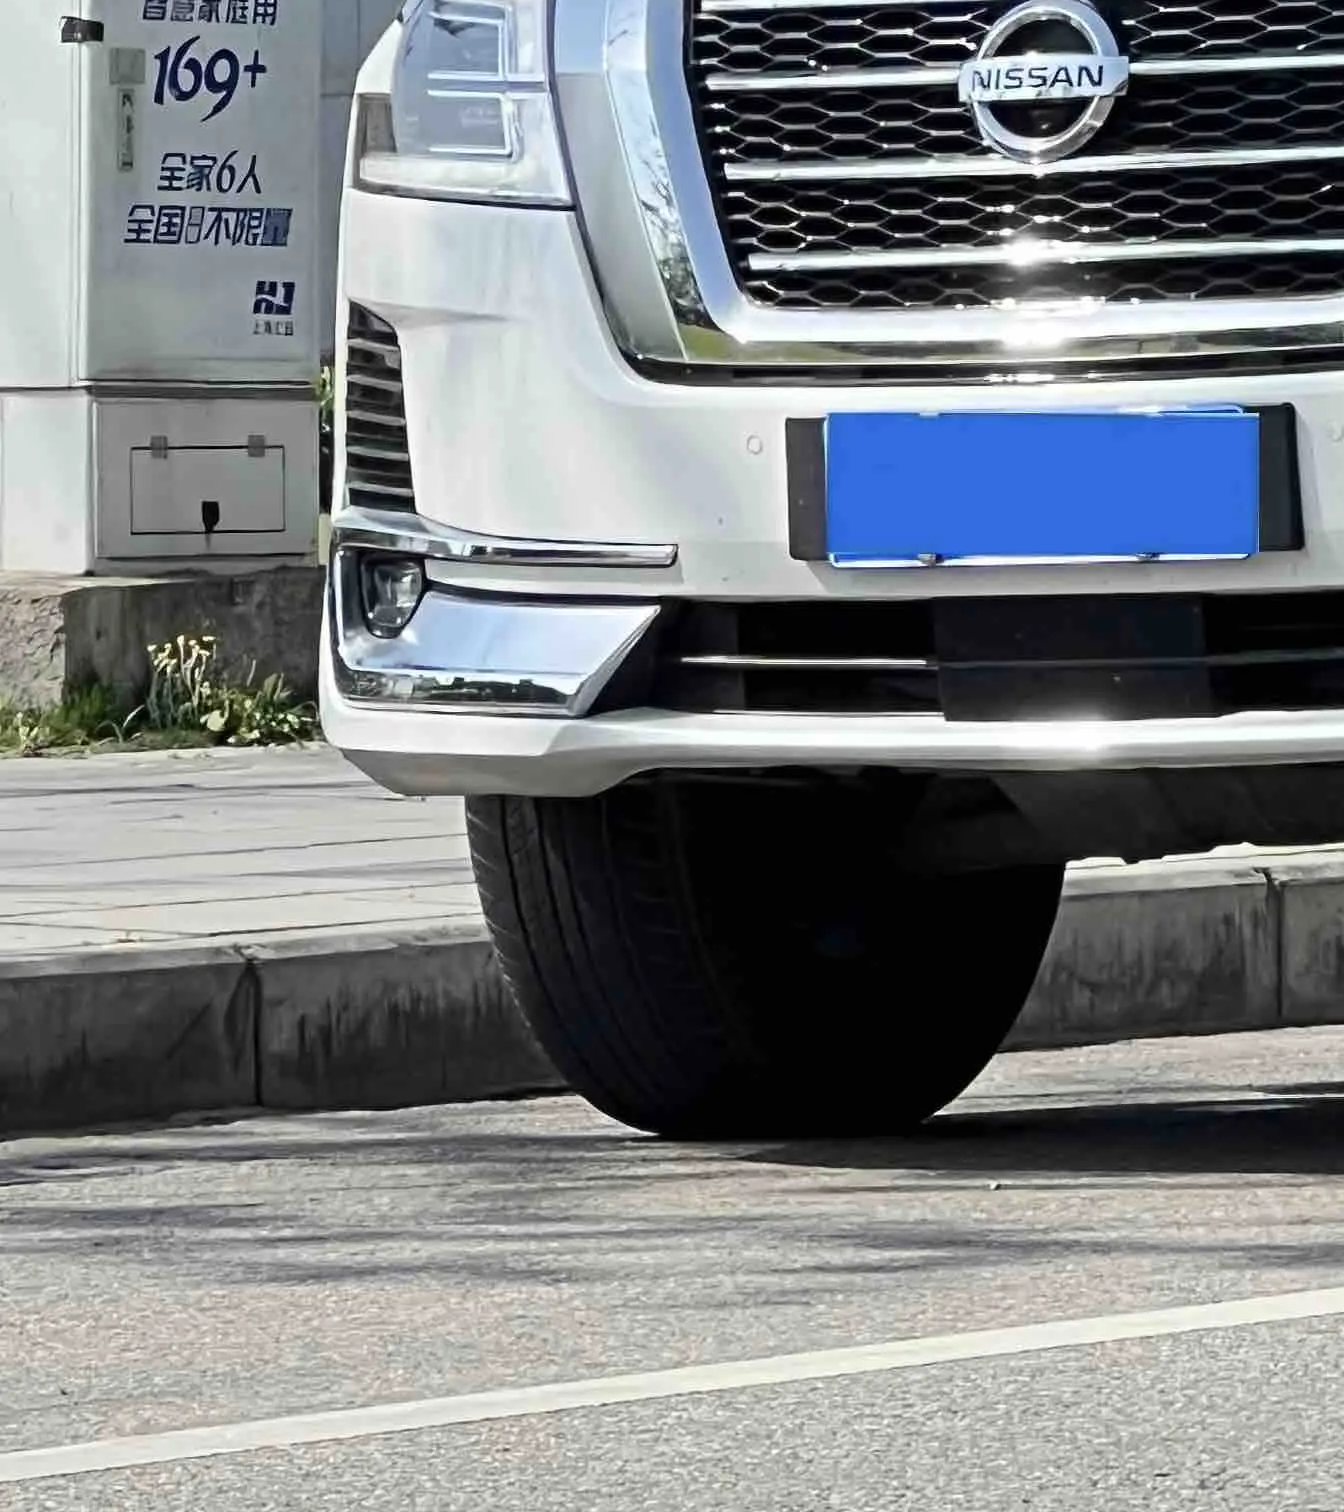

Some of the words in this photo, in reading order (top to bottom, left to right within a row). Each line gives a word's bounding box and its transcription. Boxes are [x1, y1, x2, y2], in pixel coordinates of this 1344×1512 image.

[153, 35, 267, 123] 169+
[972, 65, 1103, 92] NISSAN
[157, 150, 262, 194] 全家6人
